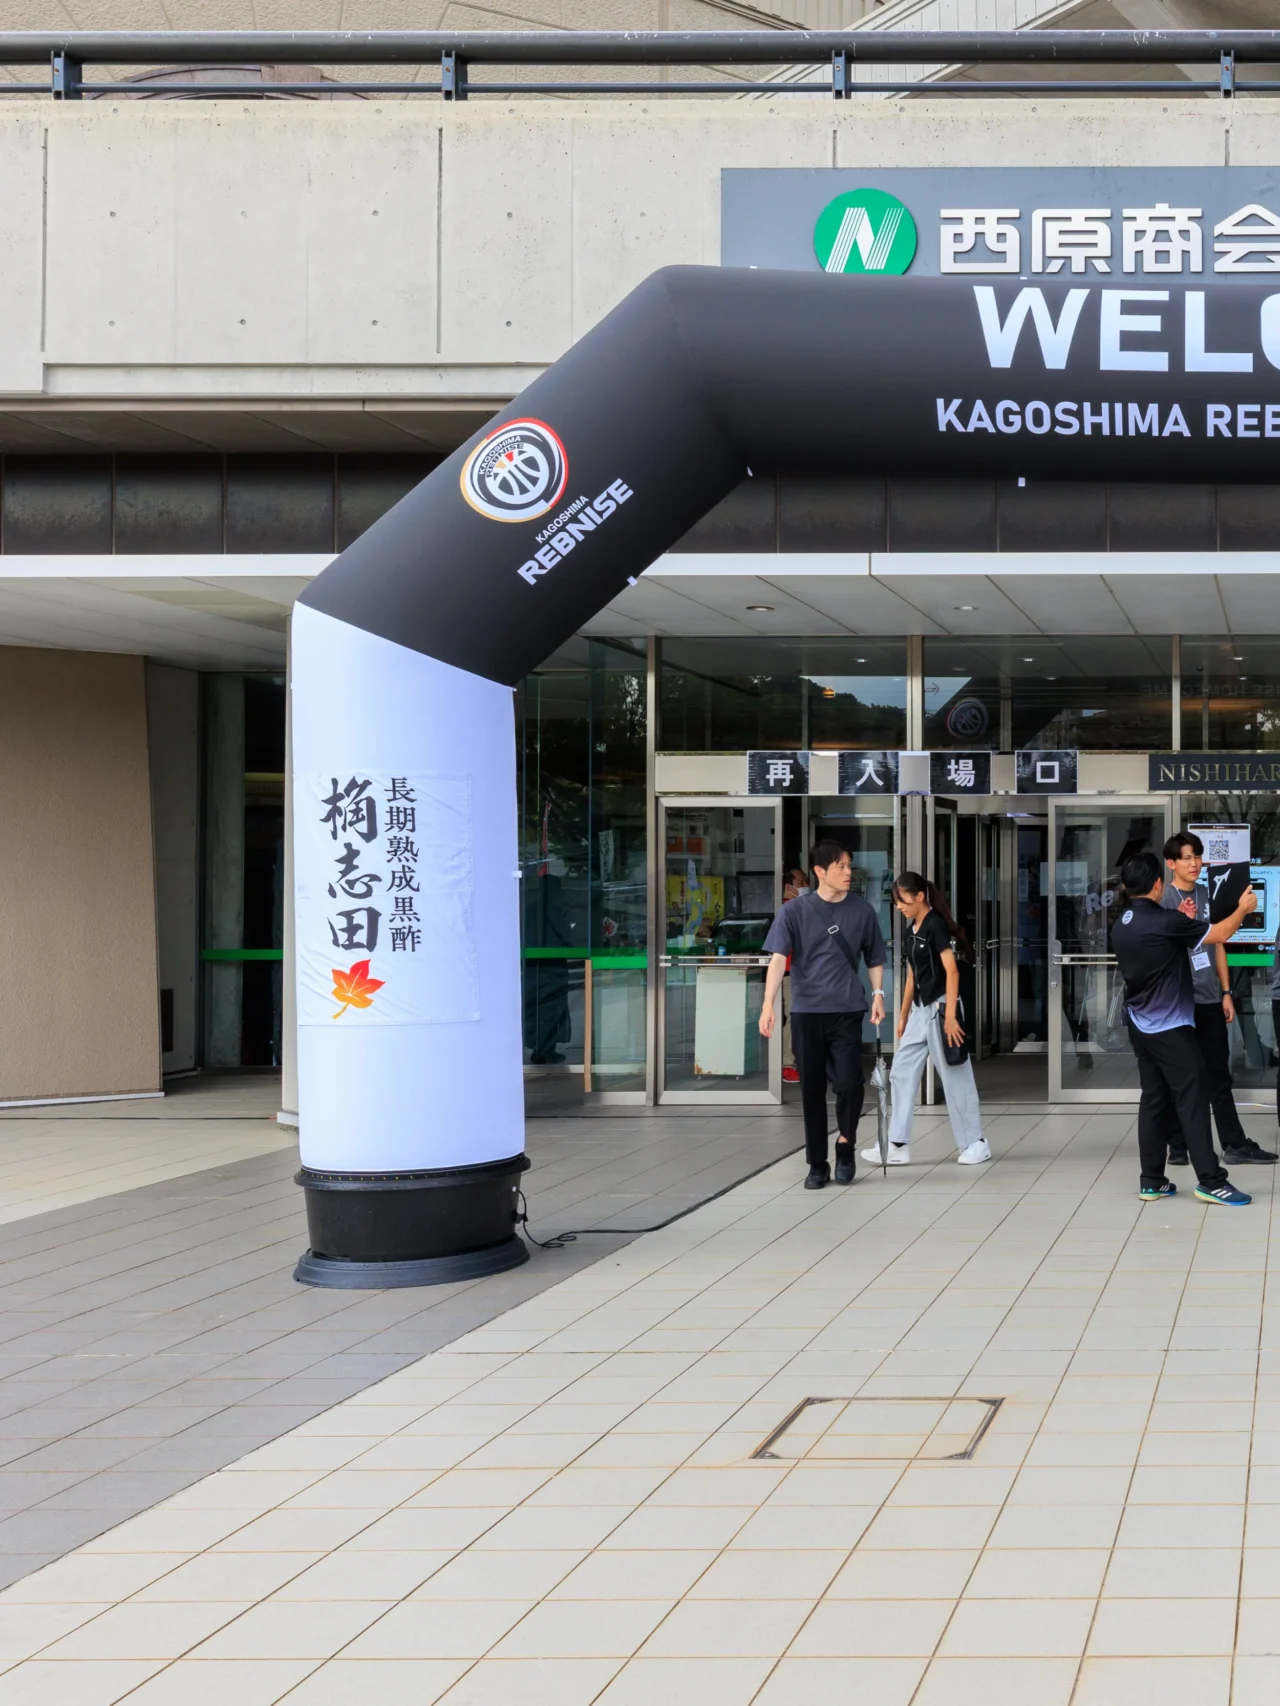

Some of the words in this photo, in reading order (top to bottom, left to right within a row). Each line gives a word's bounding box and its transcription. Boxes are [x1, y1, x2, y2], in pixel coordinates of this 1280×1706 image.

[936, 398, 1192, 437] KAGOSHIMA
[478, 436, 521, 475] KAGOSHIMA
[486, 442, 525, 478] REBNISE
[517, 478, 634, 586] REBNISE
[535, 495, 589, 544] KAGOSHIMA
[384, 777, 422, 952] 長期熟成黒酢
